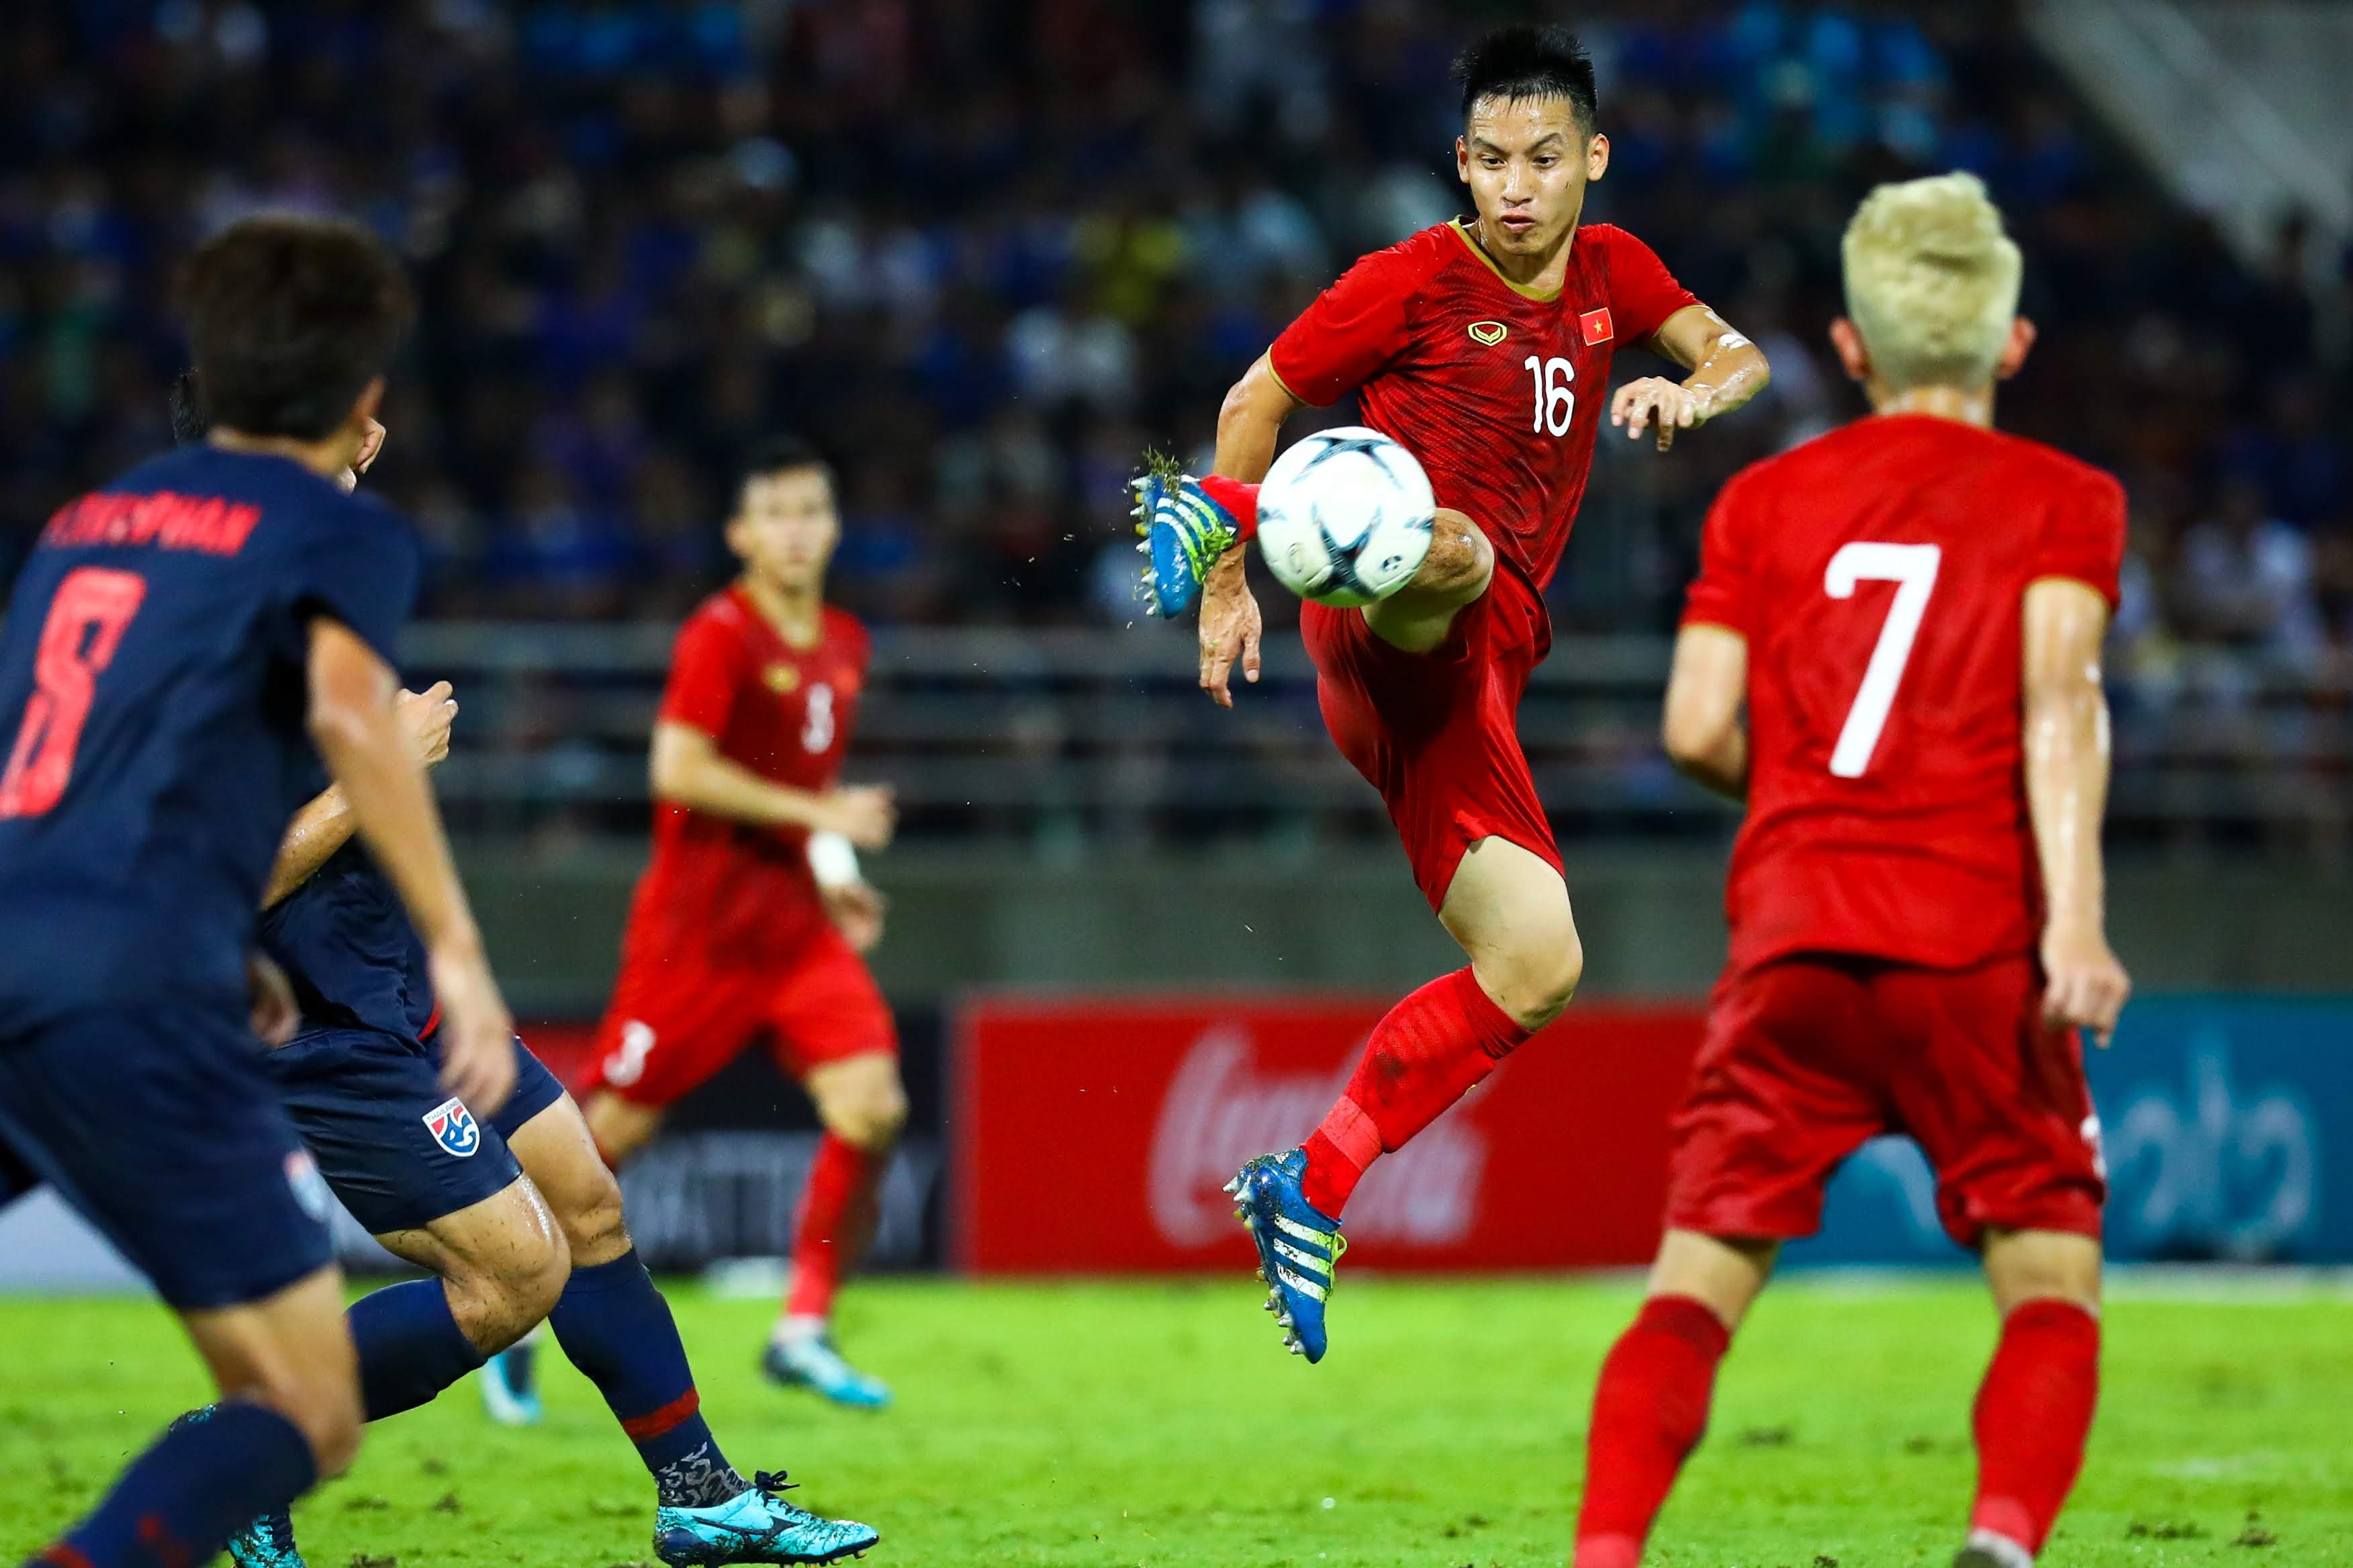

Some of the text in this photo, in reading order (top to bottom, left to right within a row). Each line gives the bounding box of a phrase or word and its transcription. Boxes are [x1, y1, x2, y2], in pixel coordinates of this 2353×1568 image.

[1524, 355, 1575, 437] 16
[0, 565, 148, 819] 8
[1824, 541, 1942, 778] 7
[602, 1019, 657, 1087] 3
[426, 1100, 460, 1122] THAILAND
